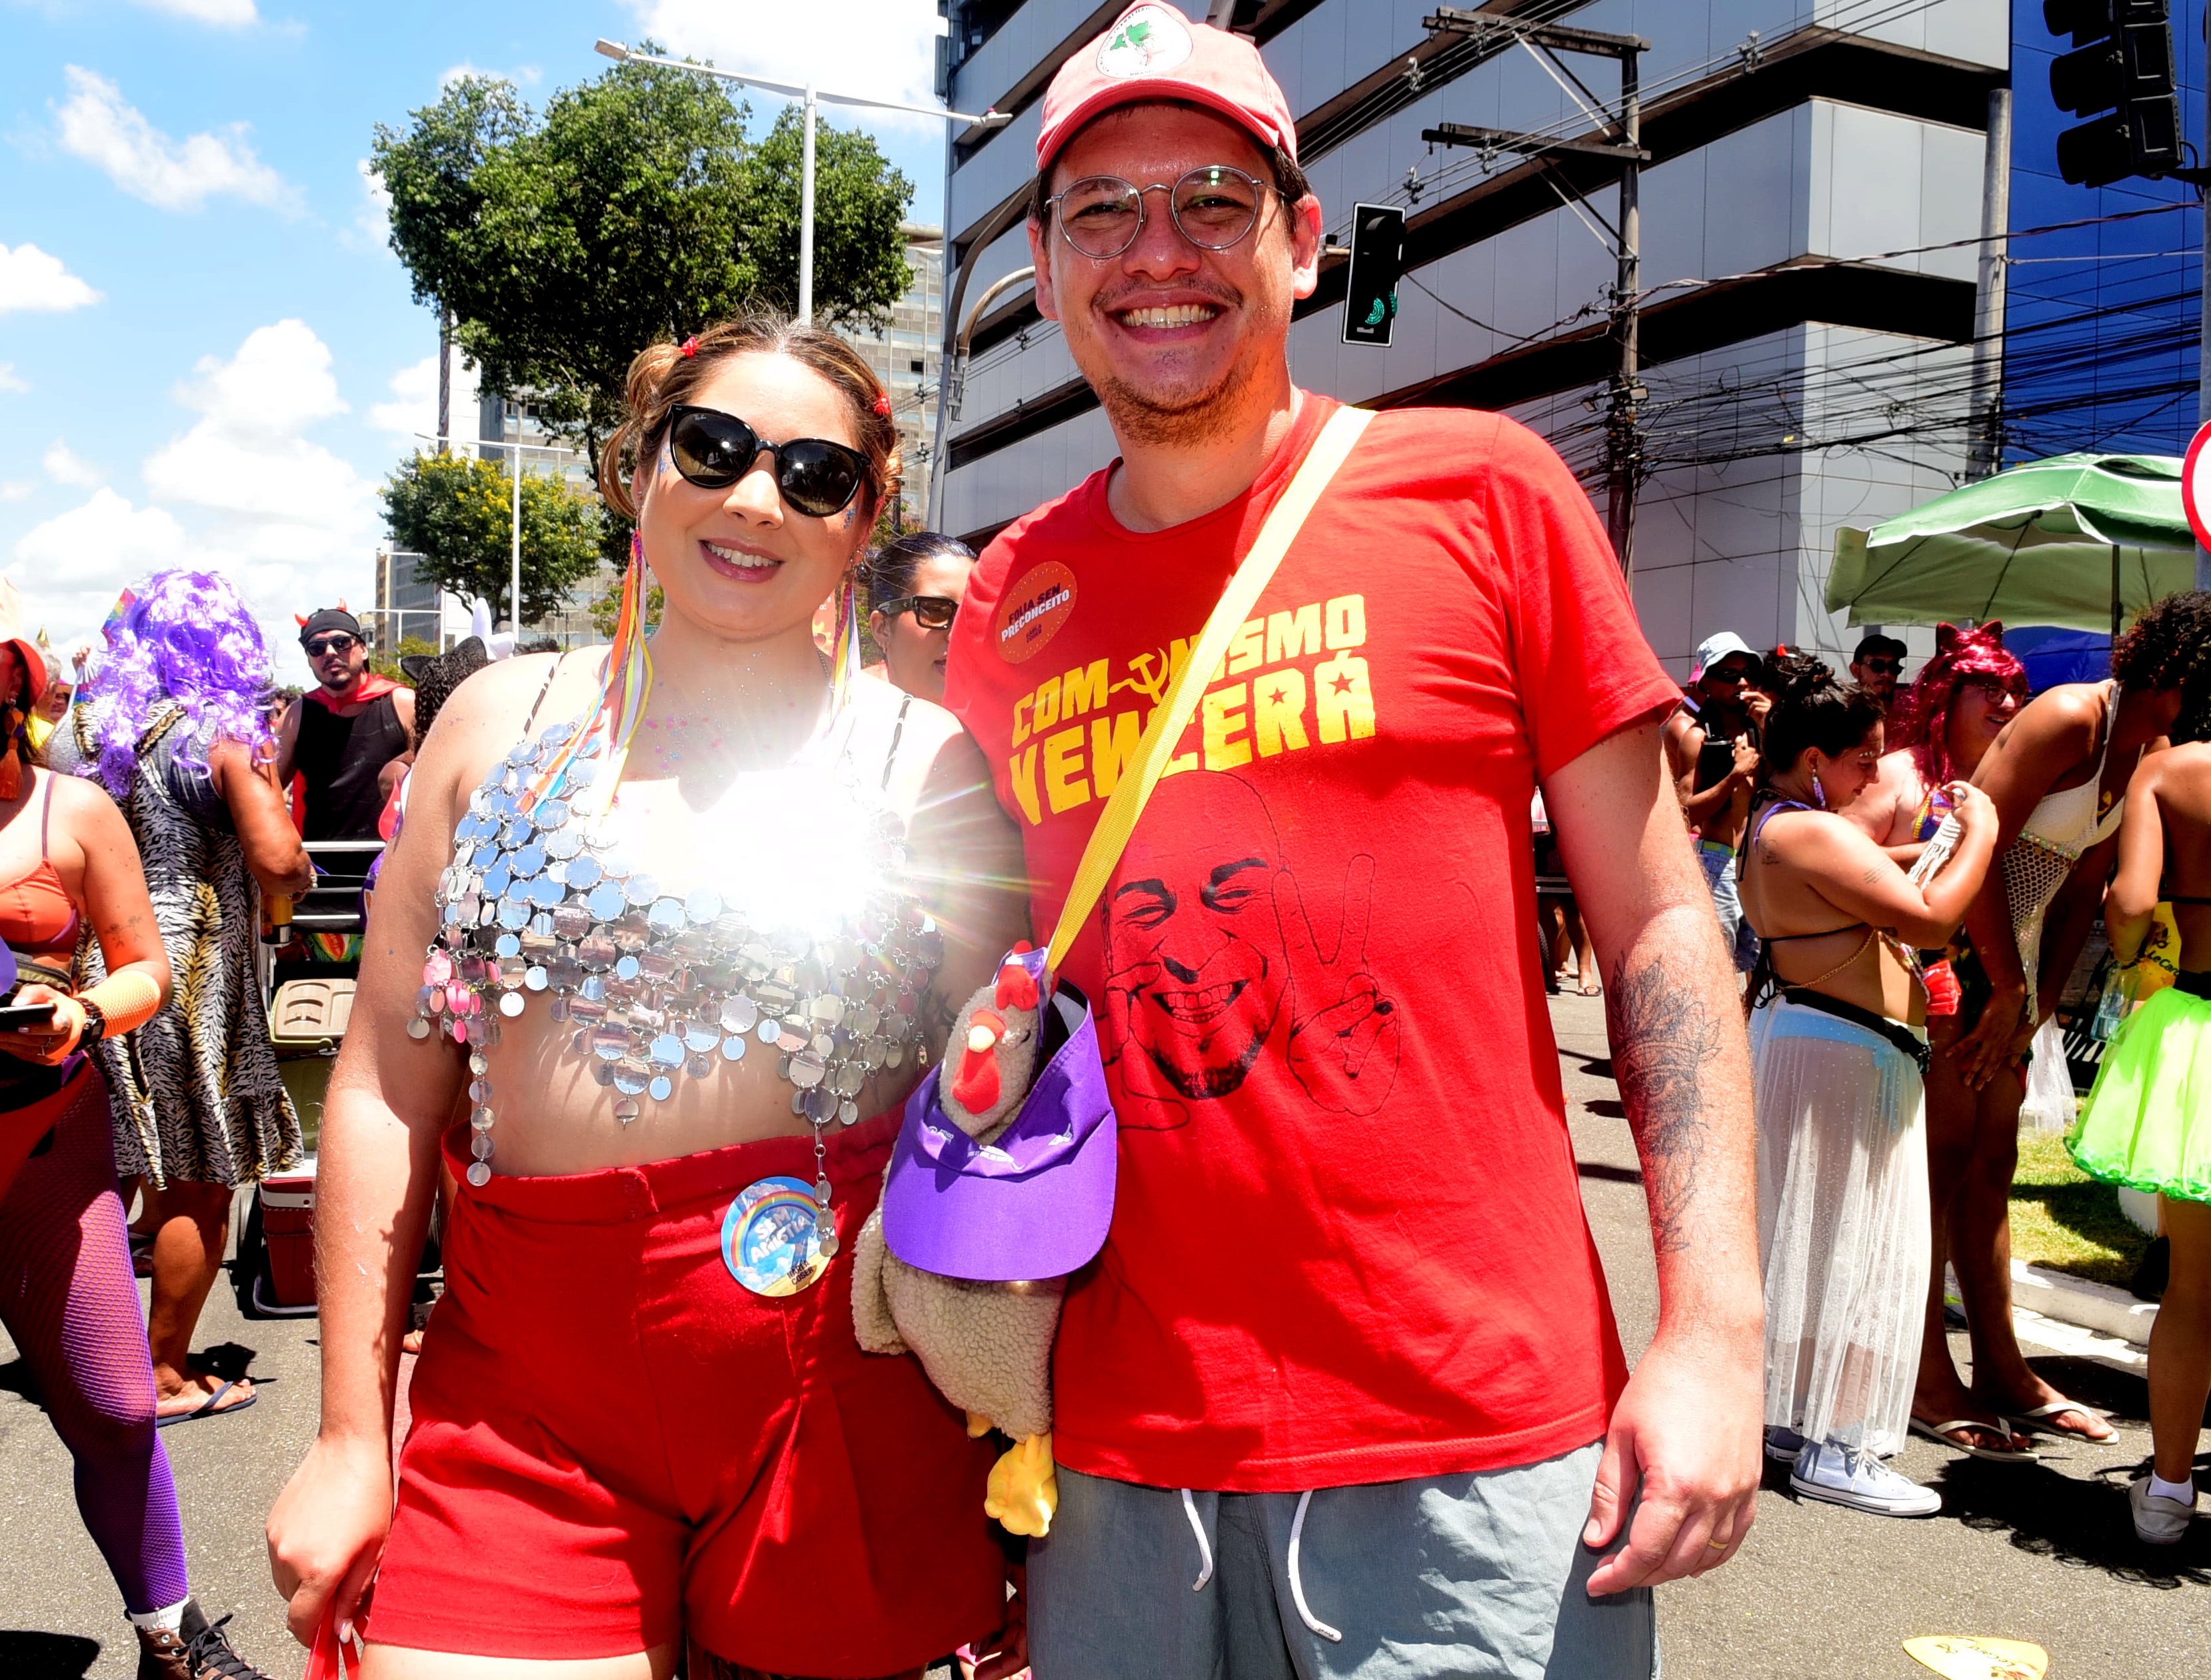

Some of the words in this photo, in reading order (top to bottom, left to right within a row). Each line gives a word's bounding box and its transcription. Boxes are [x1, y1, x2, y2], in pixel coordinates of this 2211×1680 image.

[1001, 589, 1070, 643] PRECONCEITO
[1009, 598, 1035, 625] FOLIA
[1037, 582, 1061, 604] SEM
[1011, 594, 1366, 749] COMSMO
[755, 1208, 791, 1240] SEM
